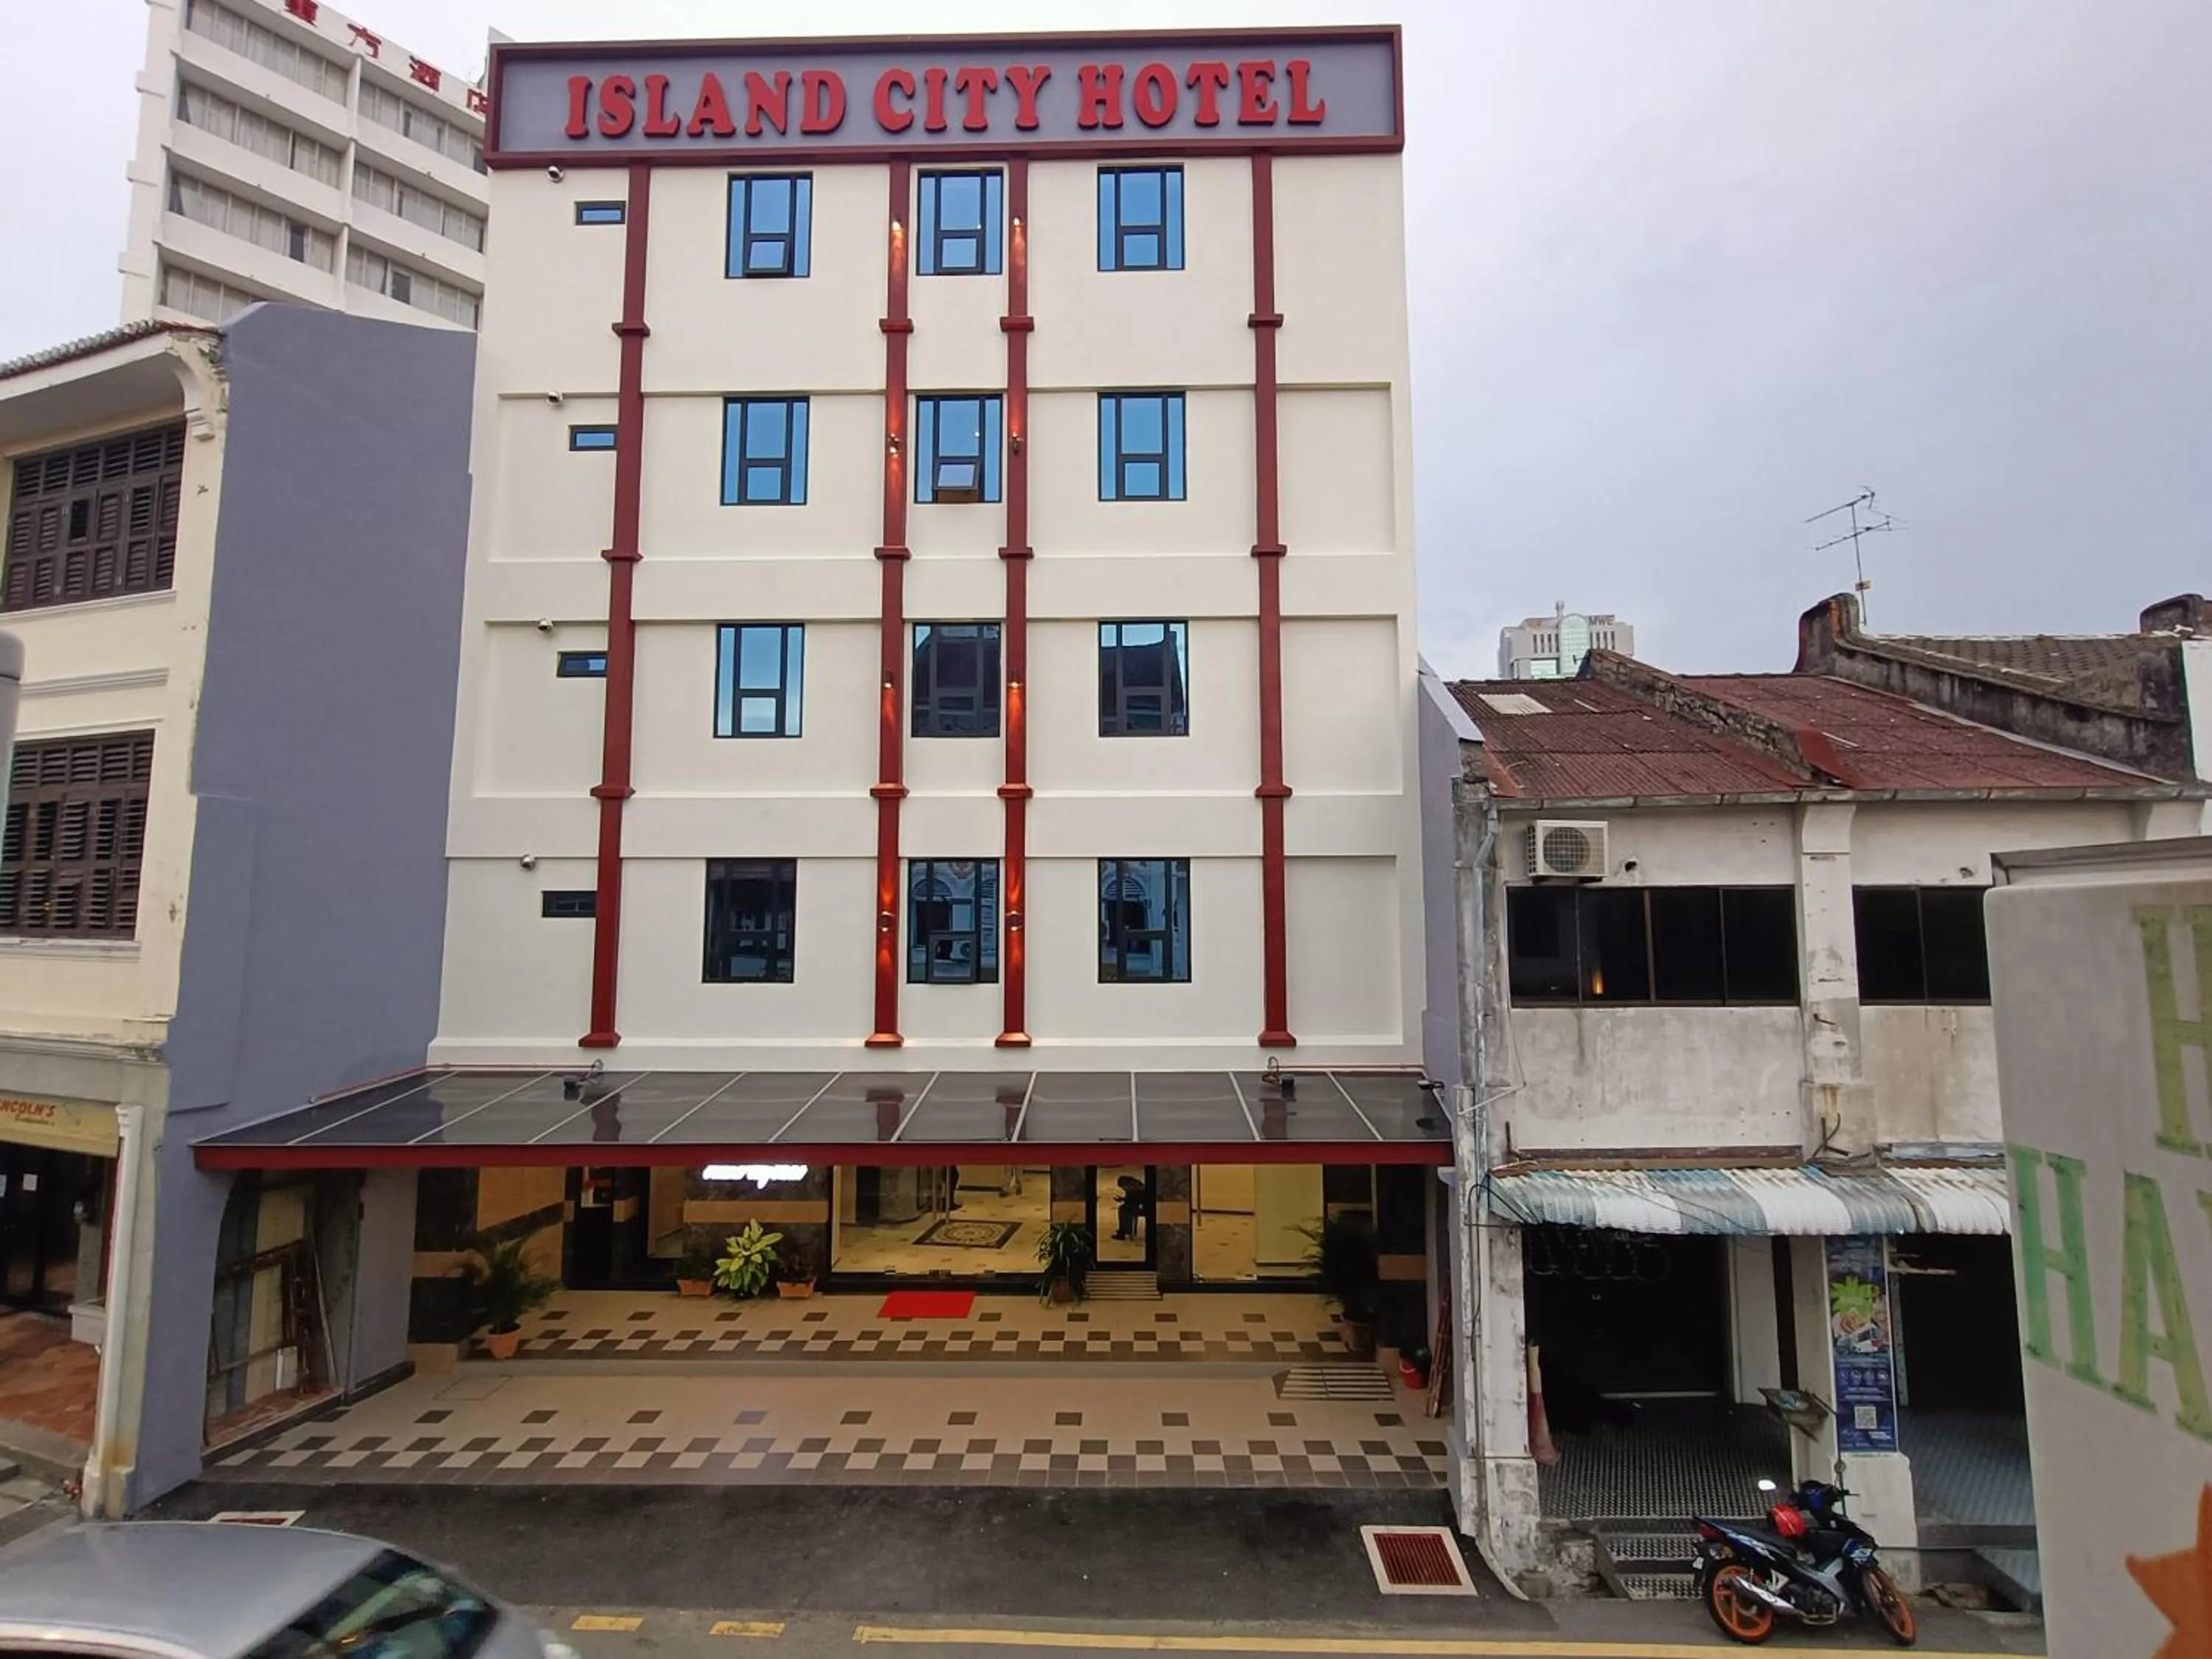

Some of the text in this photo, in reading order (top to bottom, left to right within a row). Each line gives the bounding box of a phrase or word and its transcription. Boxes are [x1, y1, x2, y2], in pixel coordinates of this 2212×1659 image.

[566, 60, 1325, 138] ISLAND CITY HOTEL
[0, 1099, 57, 1116] NCOLN'S
[2006, 1142, 2212, 1443] HA
